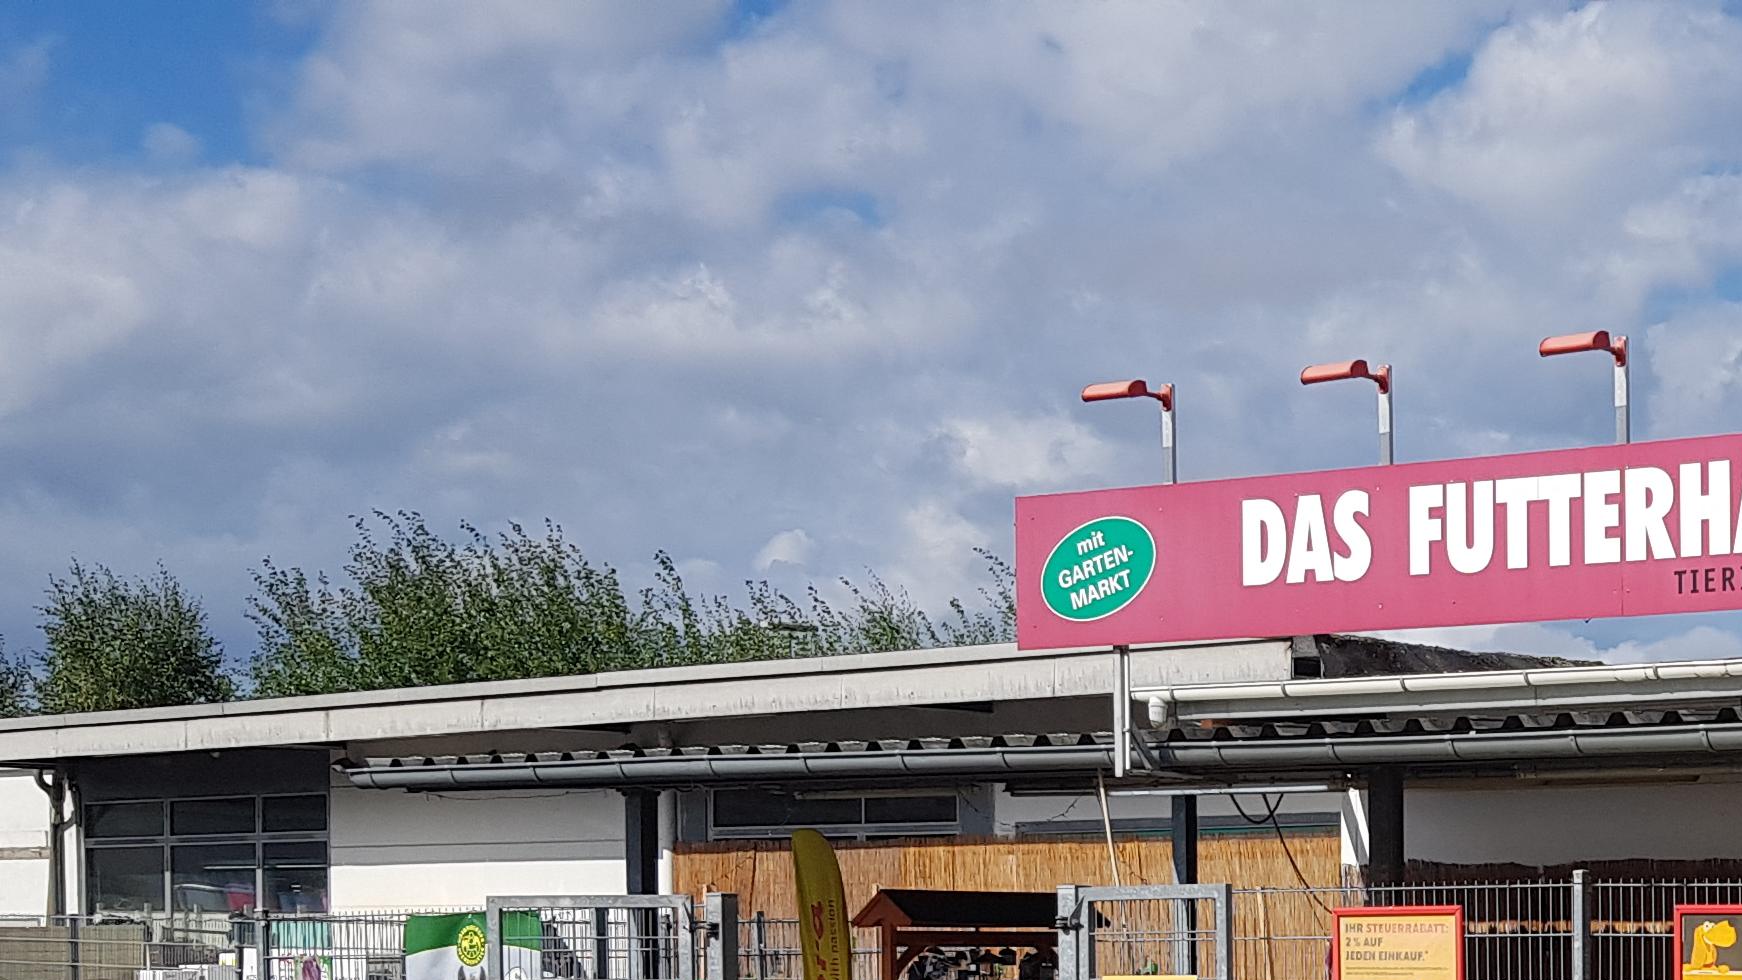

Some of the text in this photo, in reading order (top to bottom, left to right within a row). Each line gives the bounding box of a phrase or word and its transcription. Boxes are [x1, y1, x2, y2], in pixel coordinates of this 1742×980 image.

[1076, 531, 1105, 556] mit
[1241, 489, 1372, 586] DAS
[1058, 546, 1134, 589] GARTEN-
[1070, 569, 1131, 609] MARKT
[1345, 923, 1449, 934] IHR STEUERRABATT:
[1363, 937, 1383, 947] AUF
[1345, 951, 1376, 961] JEDEN
